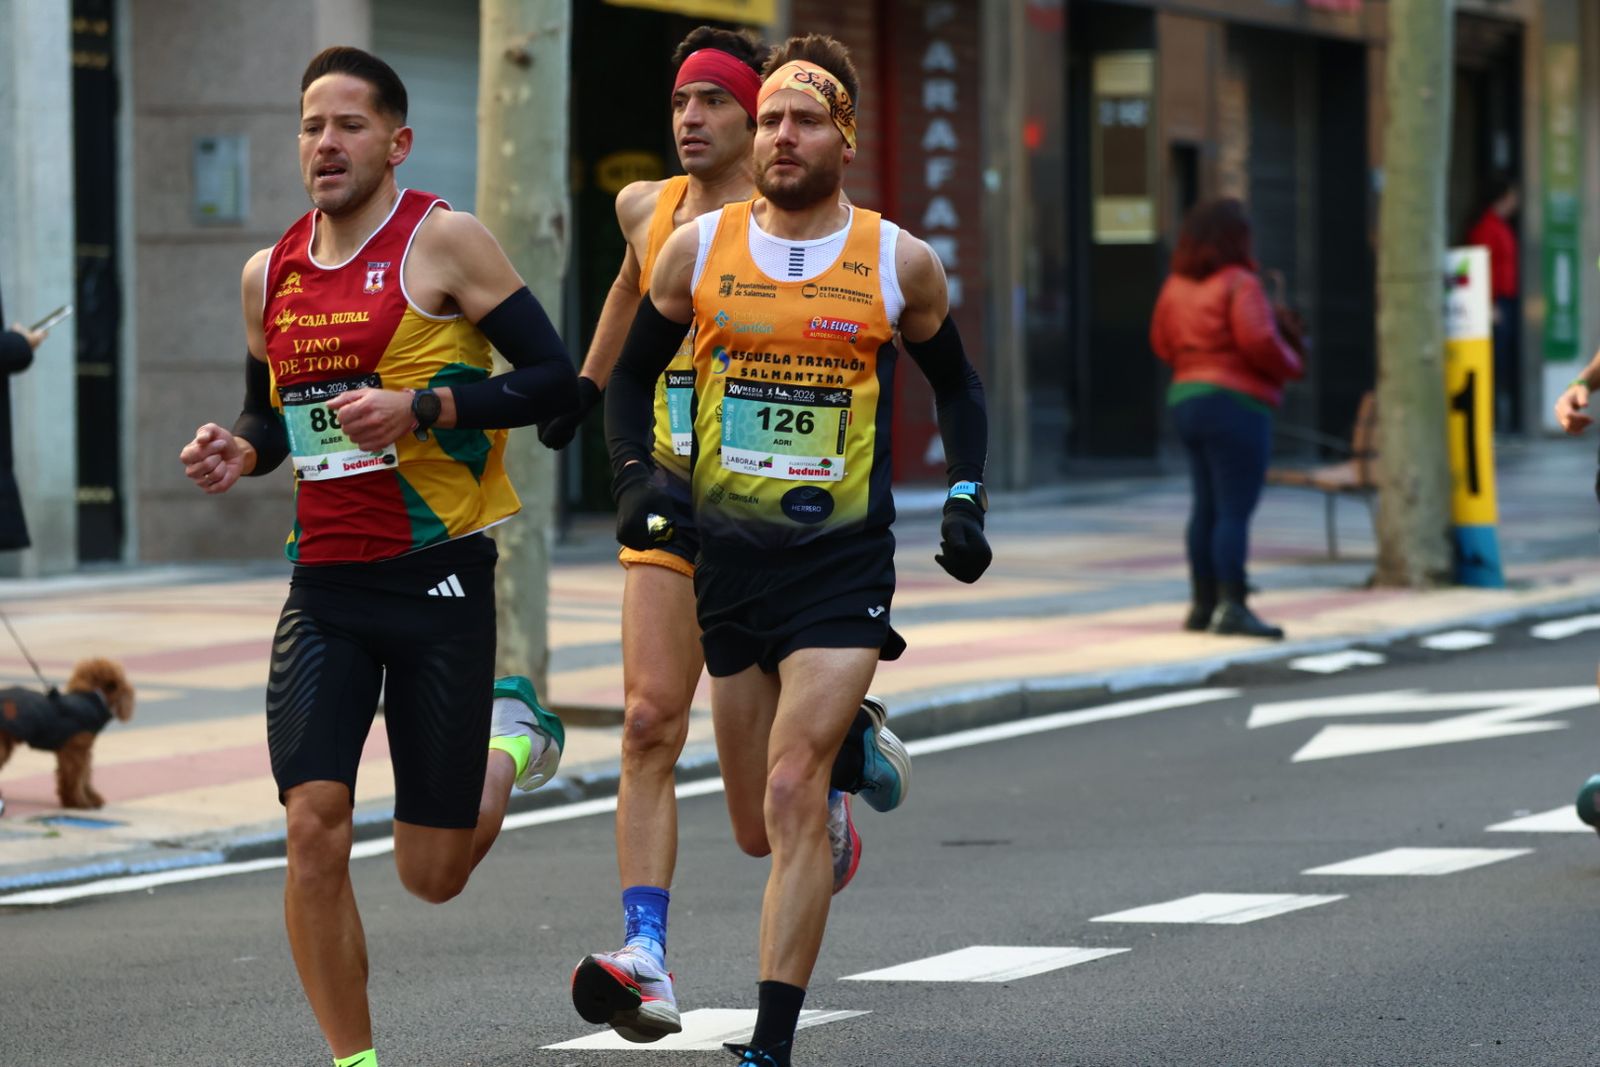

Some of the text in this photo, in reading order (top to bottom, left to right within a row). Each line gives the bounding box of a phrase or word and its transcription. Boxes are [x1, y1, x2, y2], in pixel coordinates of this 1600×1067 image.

[736, 282, 777, 292] Ayuntamiento
[743, 290, 776, 299] Salamanca
[848, 295, 873, 305] DENTAL
[298, 311, 370, 327] CAJA RURAL
[821, 319, 859, 334] A. ELICES
[293, 337, 340, 354] VINO
[279, 354, 359, 377] DE TORO
[731, 350, 866, 371] ESCUELA TRIATLÓN
[741, 367, 844, 385] SALMANTINA
[327, 382, 349, 394] 2026
[728, 384, 744, 394] XIV
[793, 389, 815, 400] 2026
[756, 406, 815, 435] 126
[1452, 369, 1480, 495] 1
[320, 436, 343, 446] ALBER
[773, 438, 792, 446] ADRI
[727, 455, 758, 466] LABORAL
[788, 466, 831, 477] bedunia
